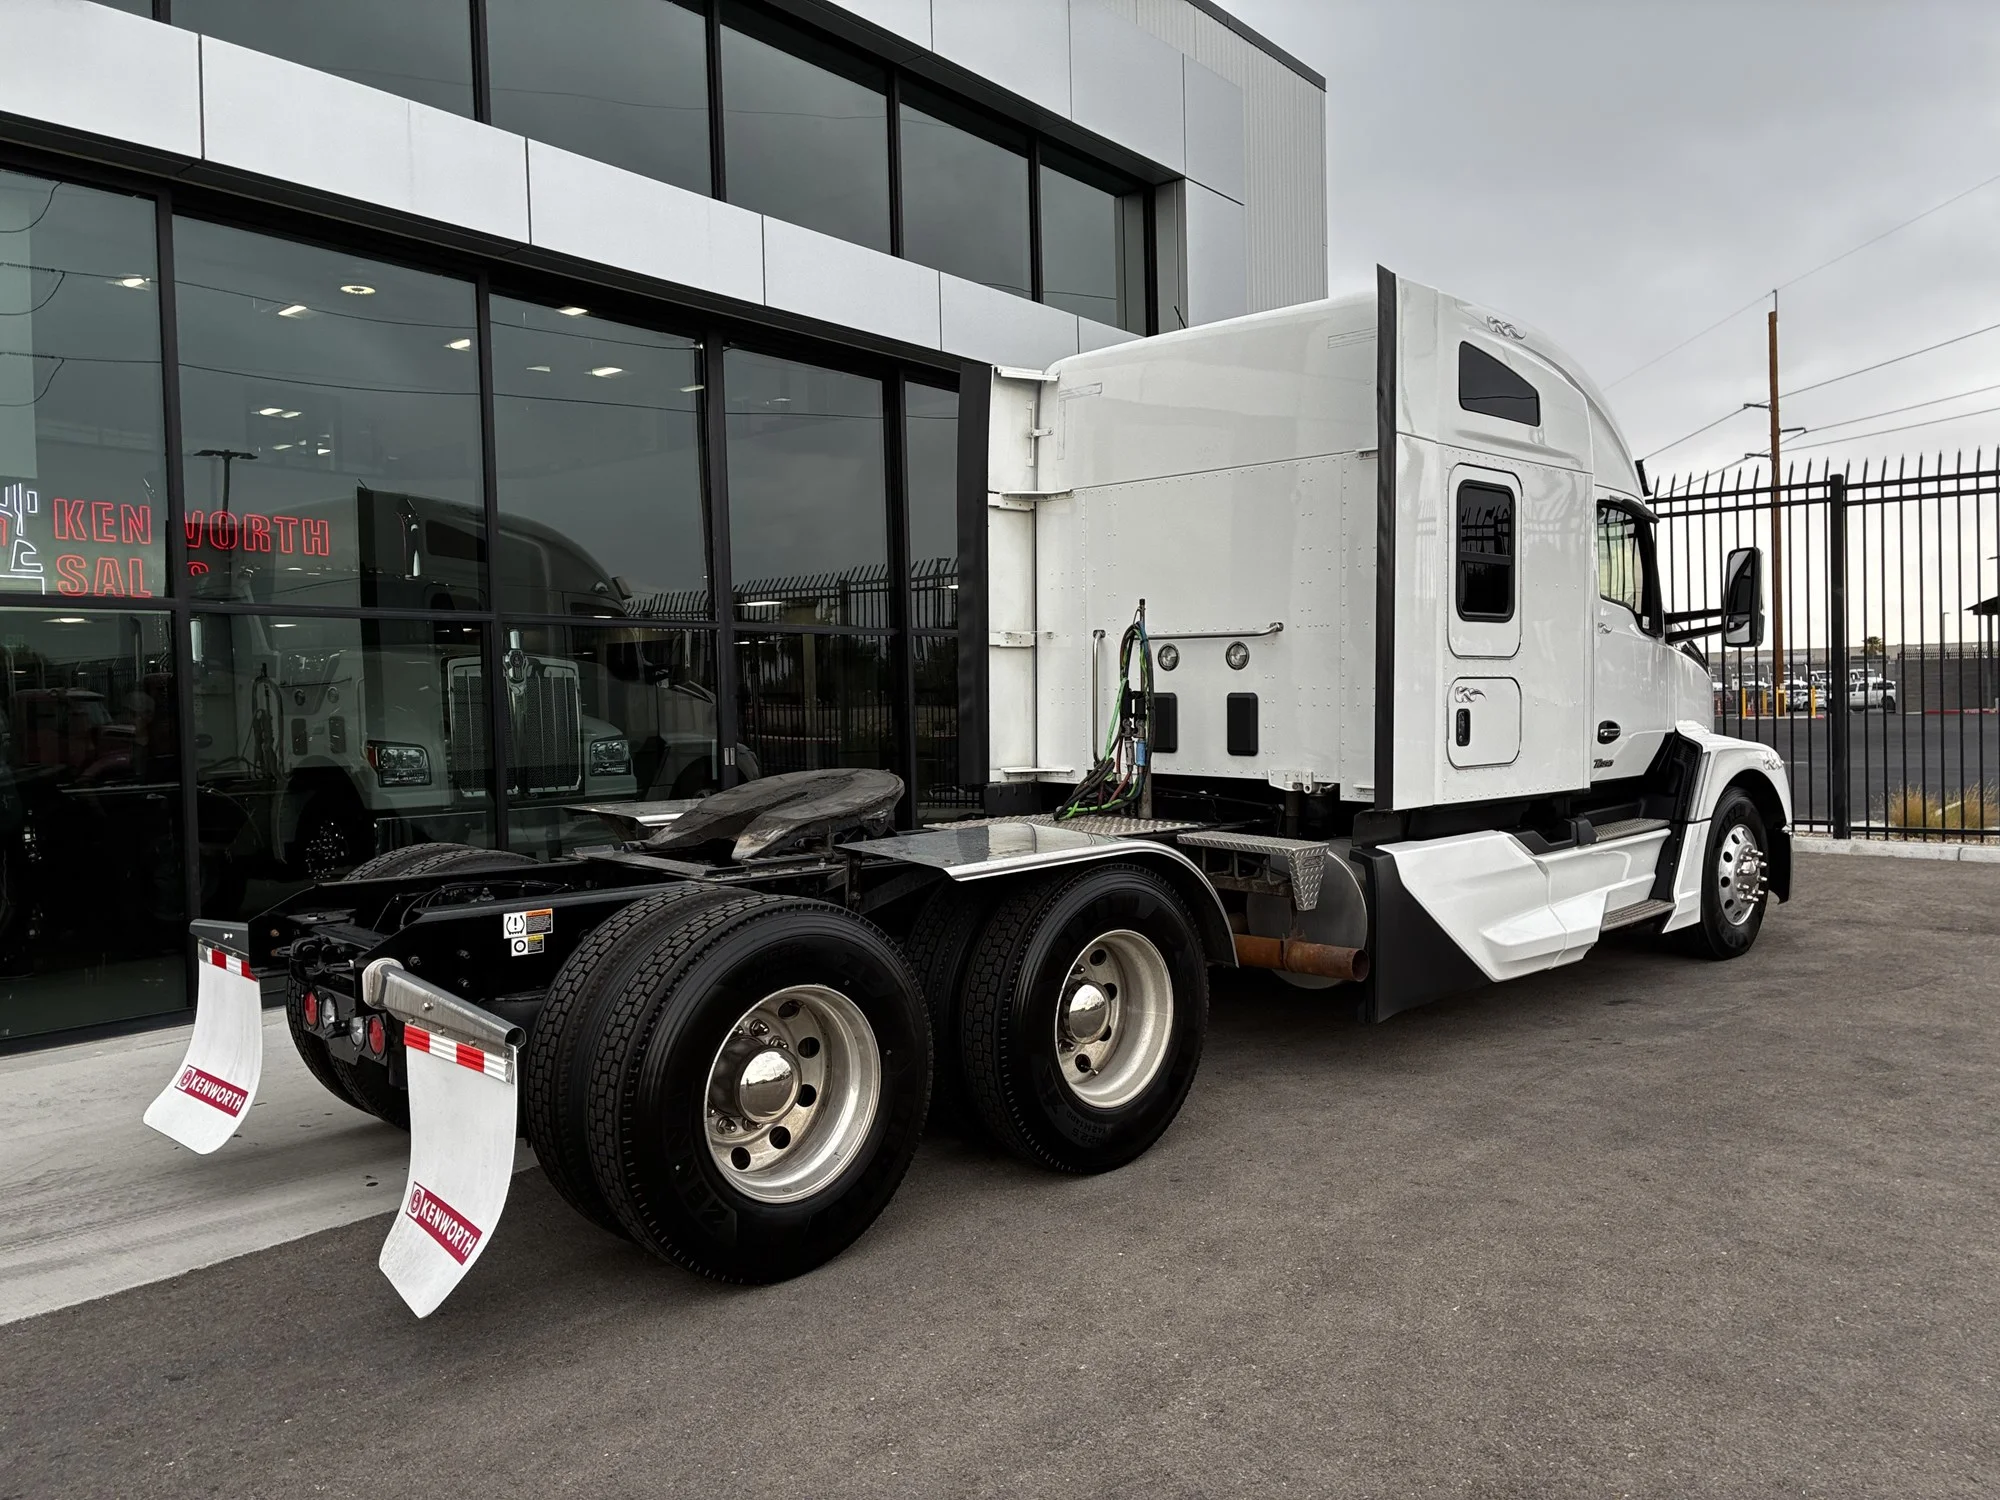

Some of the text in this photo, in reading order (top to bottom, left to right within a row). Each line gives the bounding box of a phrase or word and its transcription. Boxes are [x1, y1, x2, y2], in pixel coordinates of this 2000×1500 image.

[56, 554, 209, 599] SAL
[188, 1074, 245, 1112] KENWORTH
[419, 1197, 477, 1257] KENWORTH
